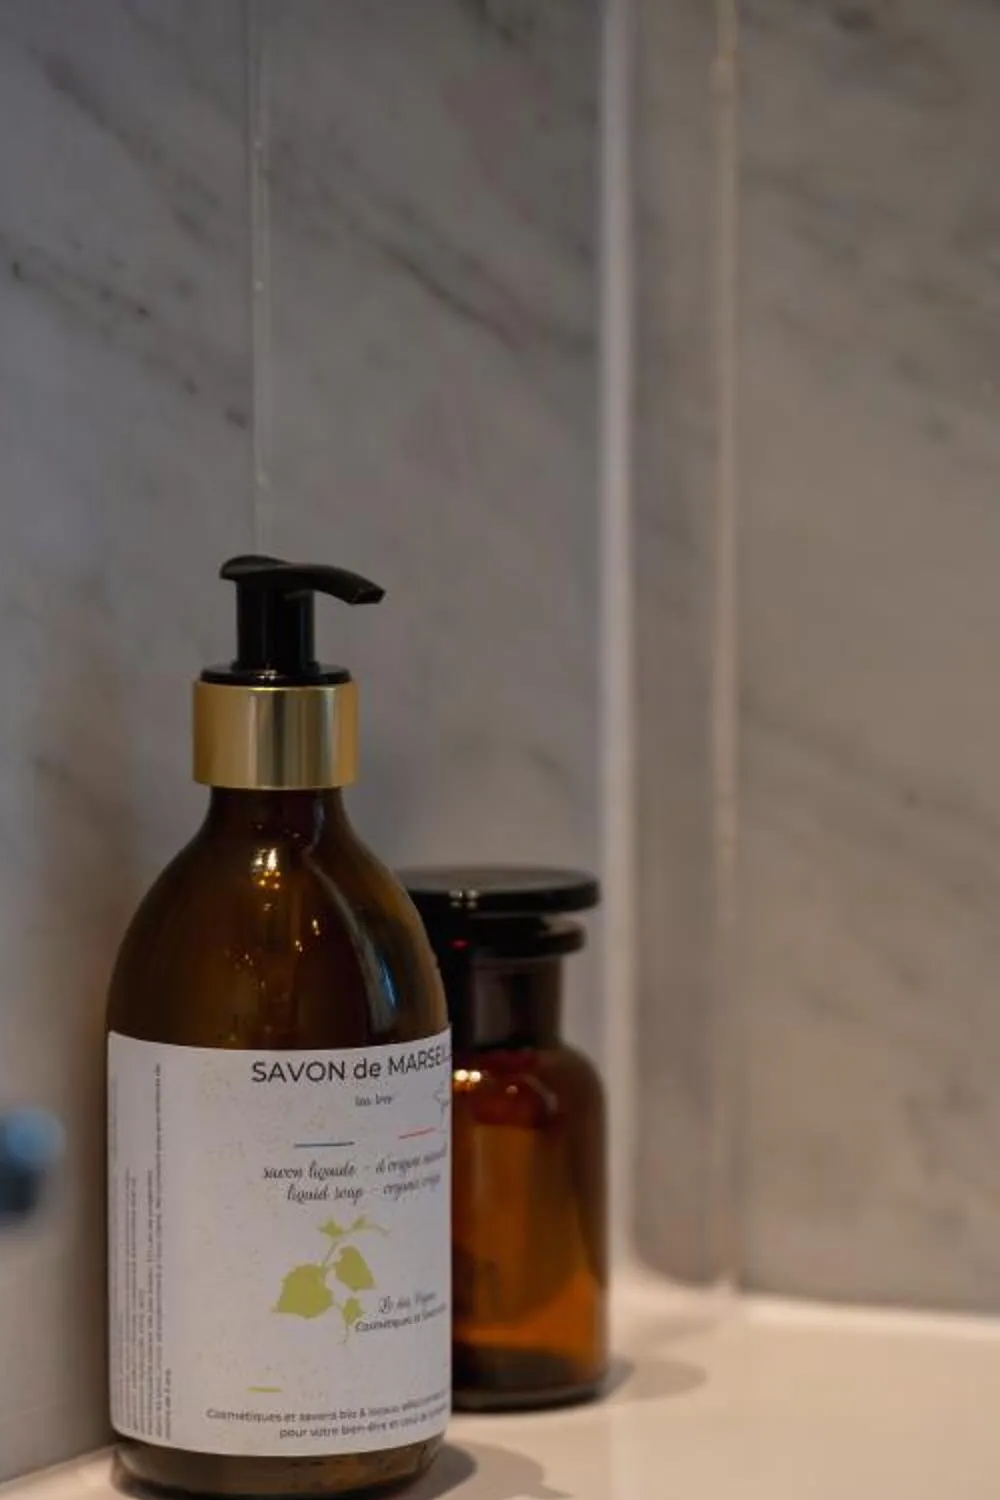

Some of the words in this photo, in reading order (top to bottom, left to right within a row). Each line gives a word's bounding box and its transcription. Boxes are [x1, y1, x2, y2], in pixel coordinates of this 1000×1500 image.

[252, 1061, 345, 1083] SAVON
[353, 1058, 382, 1080] de
[263, 1166, 303, 1180] savon
[309, 1159, 357, 1180] liquide
[287, 1183, 330, 1205] liquid
[335, 1185, 364, 1206] soap
[339, 1408, 357, 1421] bio
[279, 1427, 307, 1439] pour
[311, 1425, 340, 1438] votre
